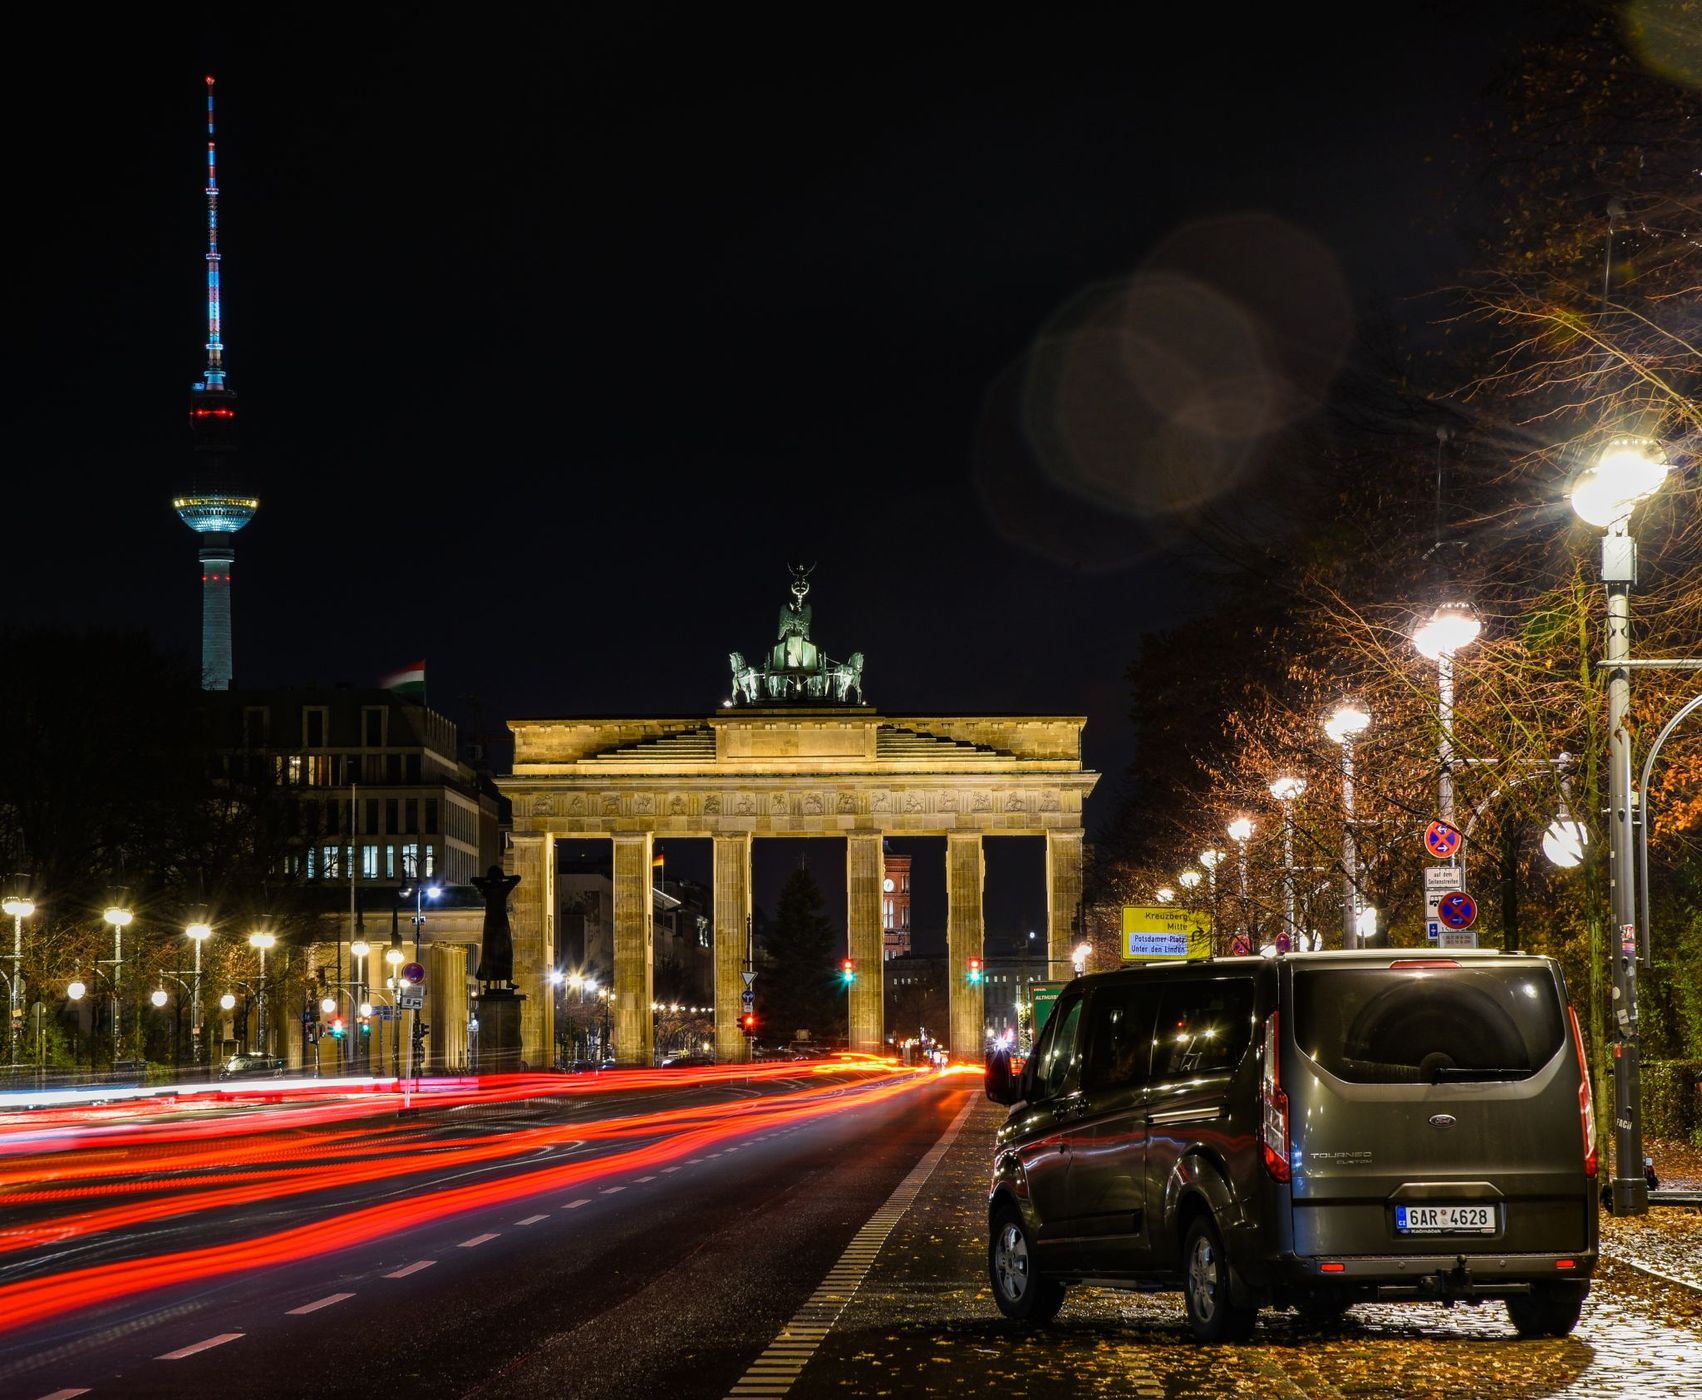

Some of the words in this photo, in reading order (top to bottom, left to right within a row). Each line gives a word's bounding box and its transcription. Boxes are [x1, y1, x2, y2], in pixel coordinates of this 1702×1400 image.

[1145, 912, 1188, 922] Kreuzberg
[1134, 935, 1167, 943] Potsdamer
[1169, 935, 1185, 943] Platz
[1131, 945, 1148, 953] Unter
[1150, 945, 1163, 953] den
[1164, 945, 1186, 953] Linden
[1409, 1209, 1438, 1226] 6AR
[1450, 1209, 1488, 1226] 4628
